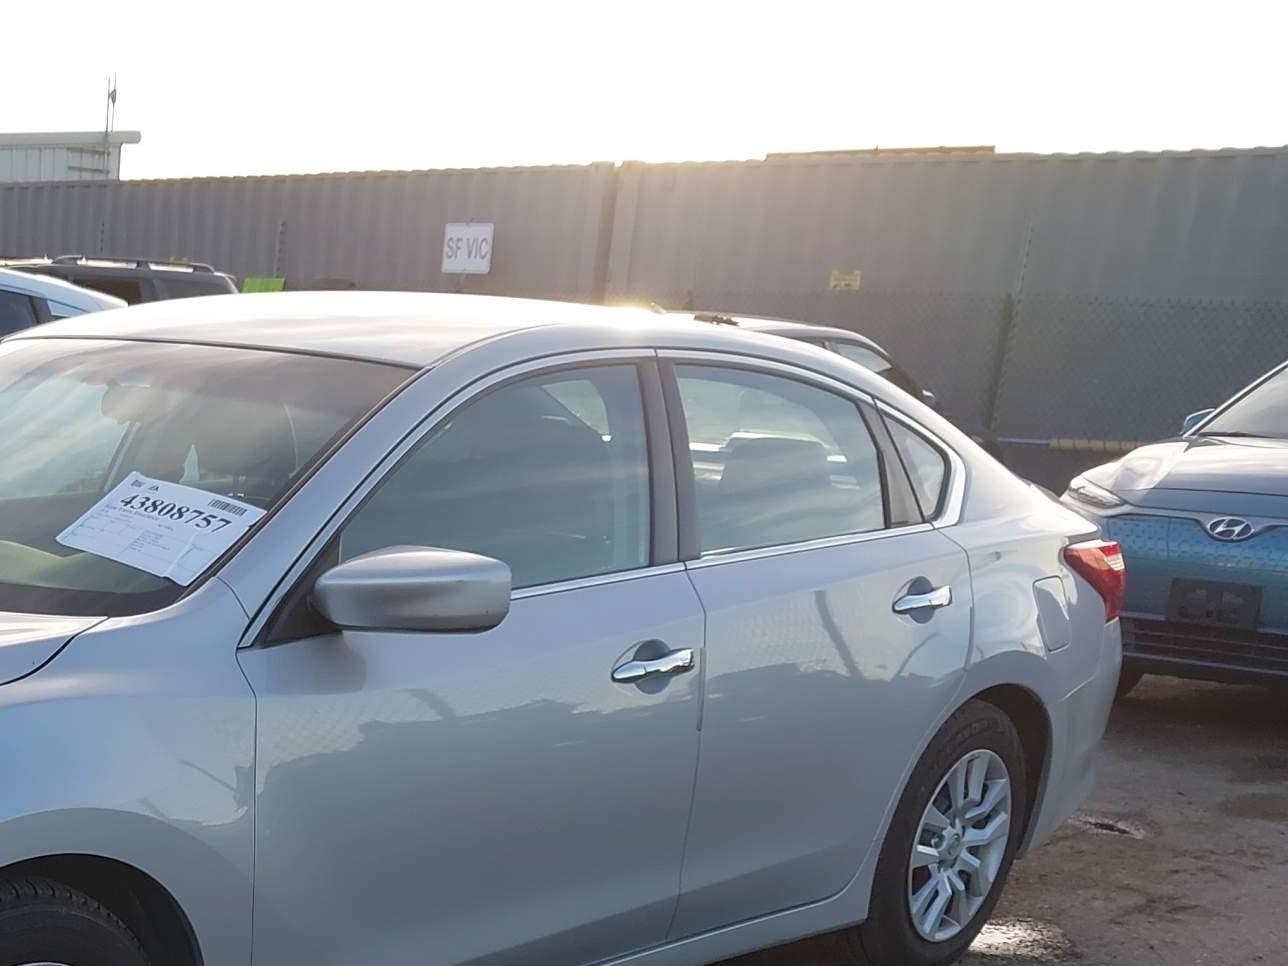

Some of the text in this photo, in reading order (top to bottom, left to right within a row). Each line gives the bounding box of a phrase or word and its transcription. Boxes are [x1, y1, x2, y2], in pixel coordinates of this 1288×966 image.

[447, 237, 489, 259] SF VIC
[120, 495, 232, 533] 43808757
